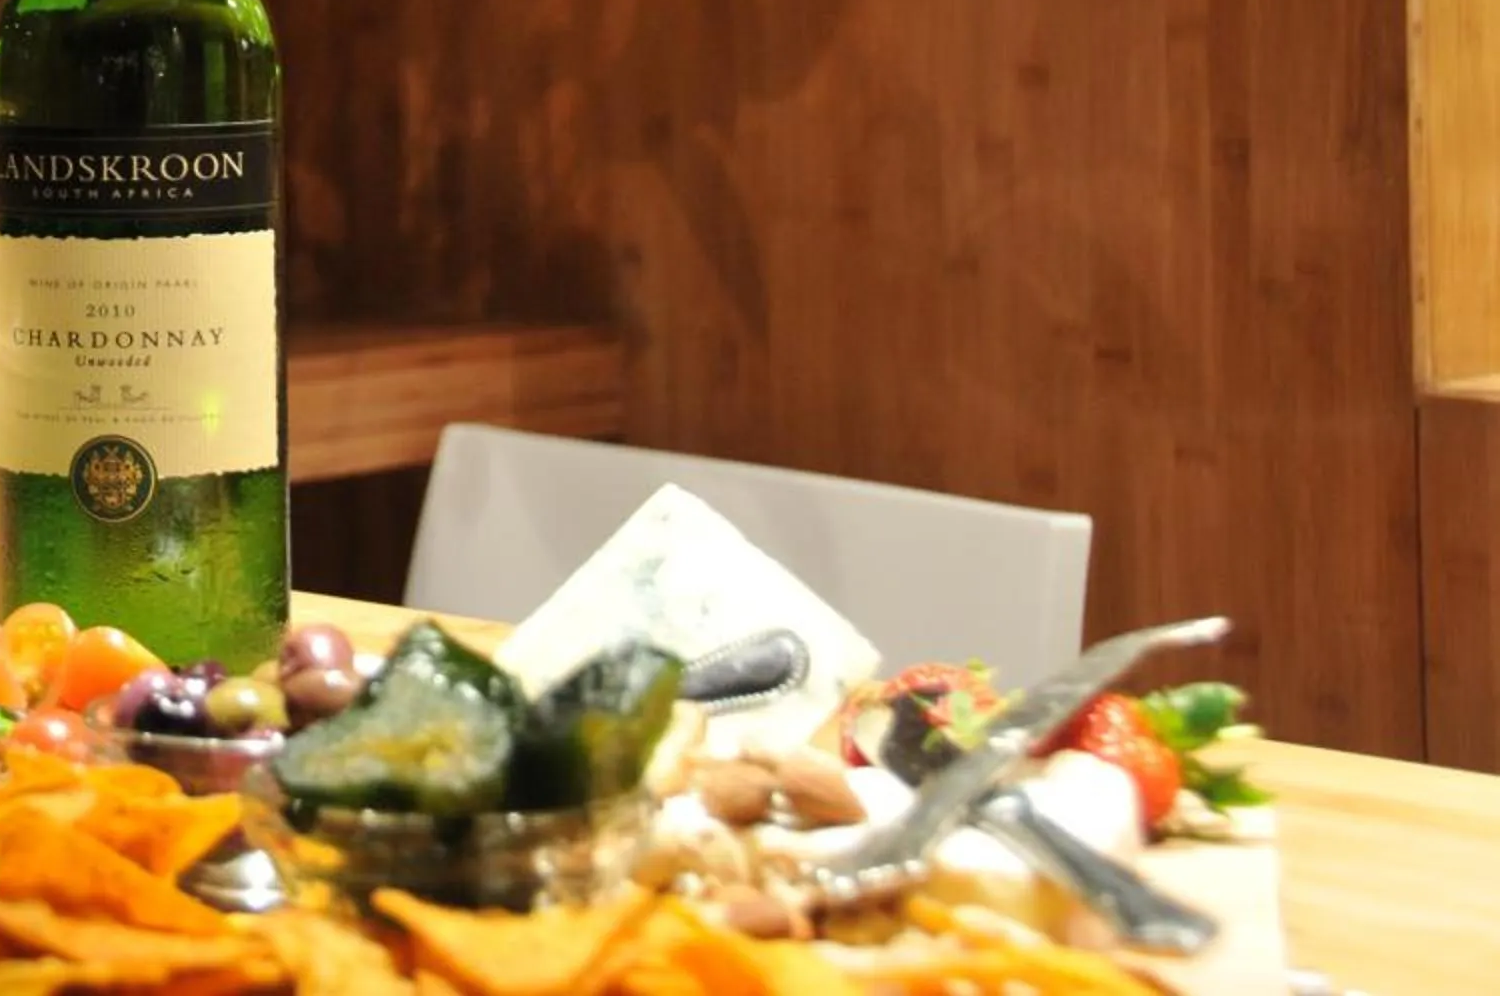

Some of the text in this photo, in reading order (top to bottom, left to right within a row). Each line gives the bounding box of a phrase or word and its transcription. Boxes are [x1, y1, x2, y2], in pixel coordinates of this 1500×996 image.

[33, 187, 194, 200] SOUTH AFRICA
[67, 280, 85, 290] OF
[93, 278, 148, 290] ORIGIN
[86, 304, 136, 319] 2010
[13, 327, 224, 349] CHARDONNAY
